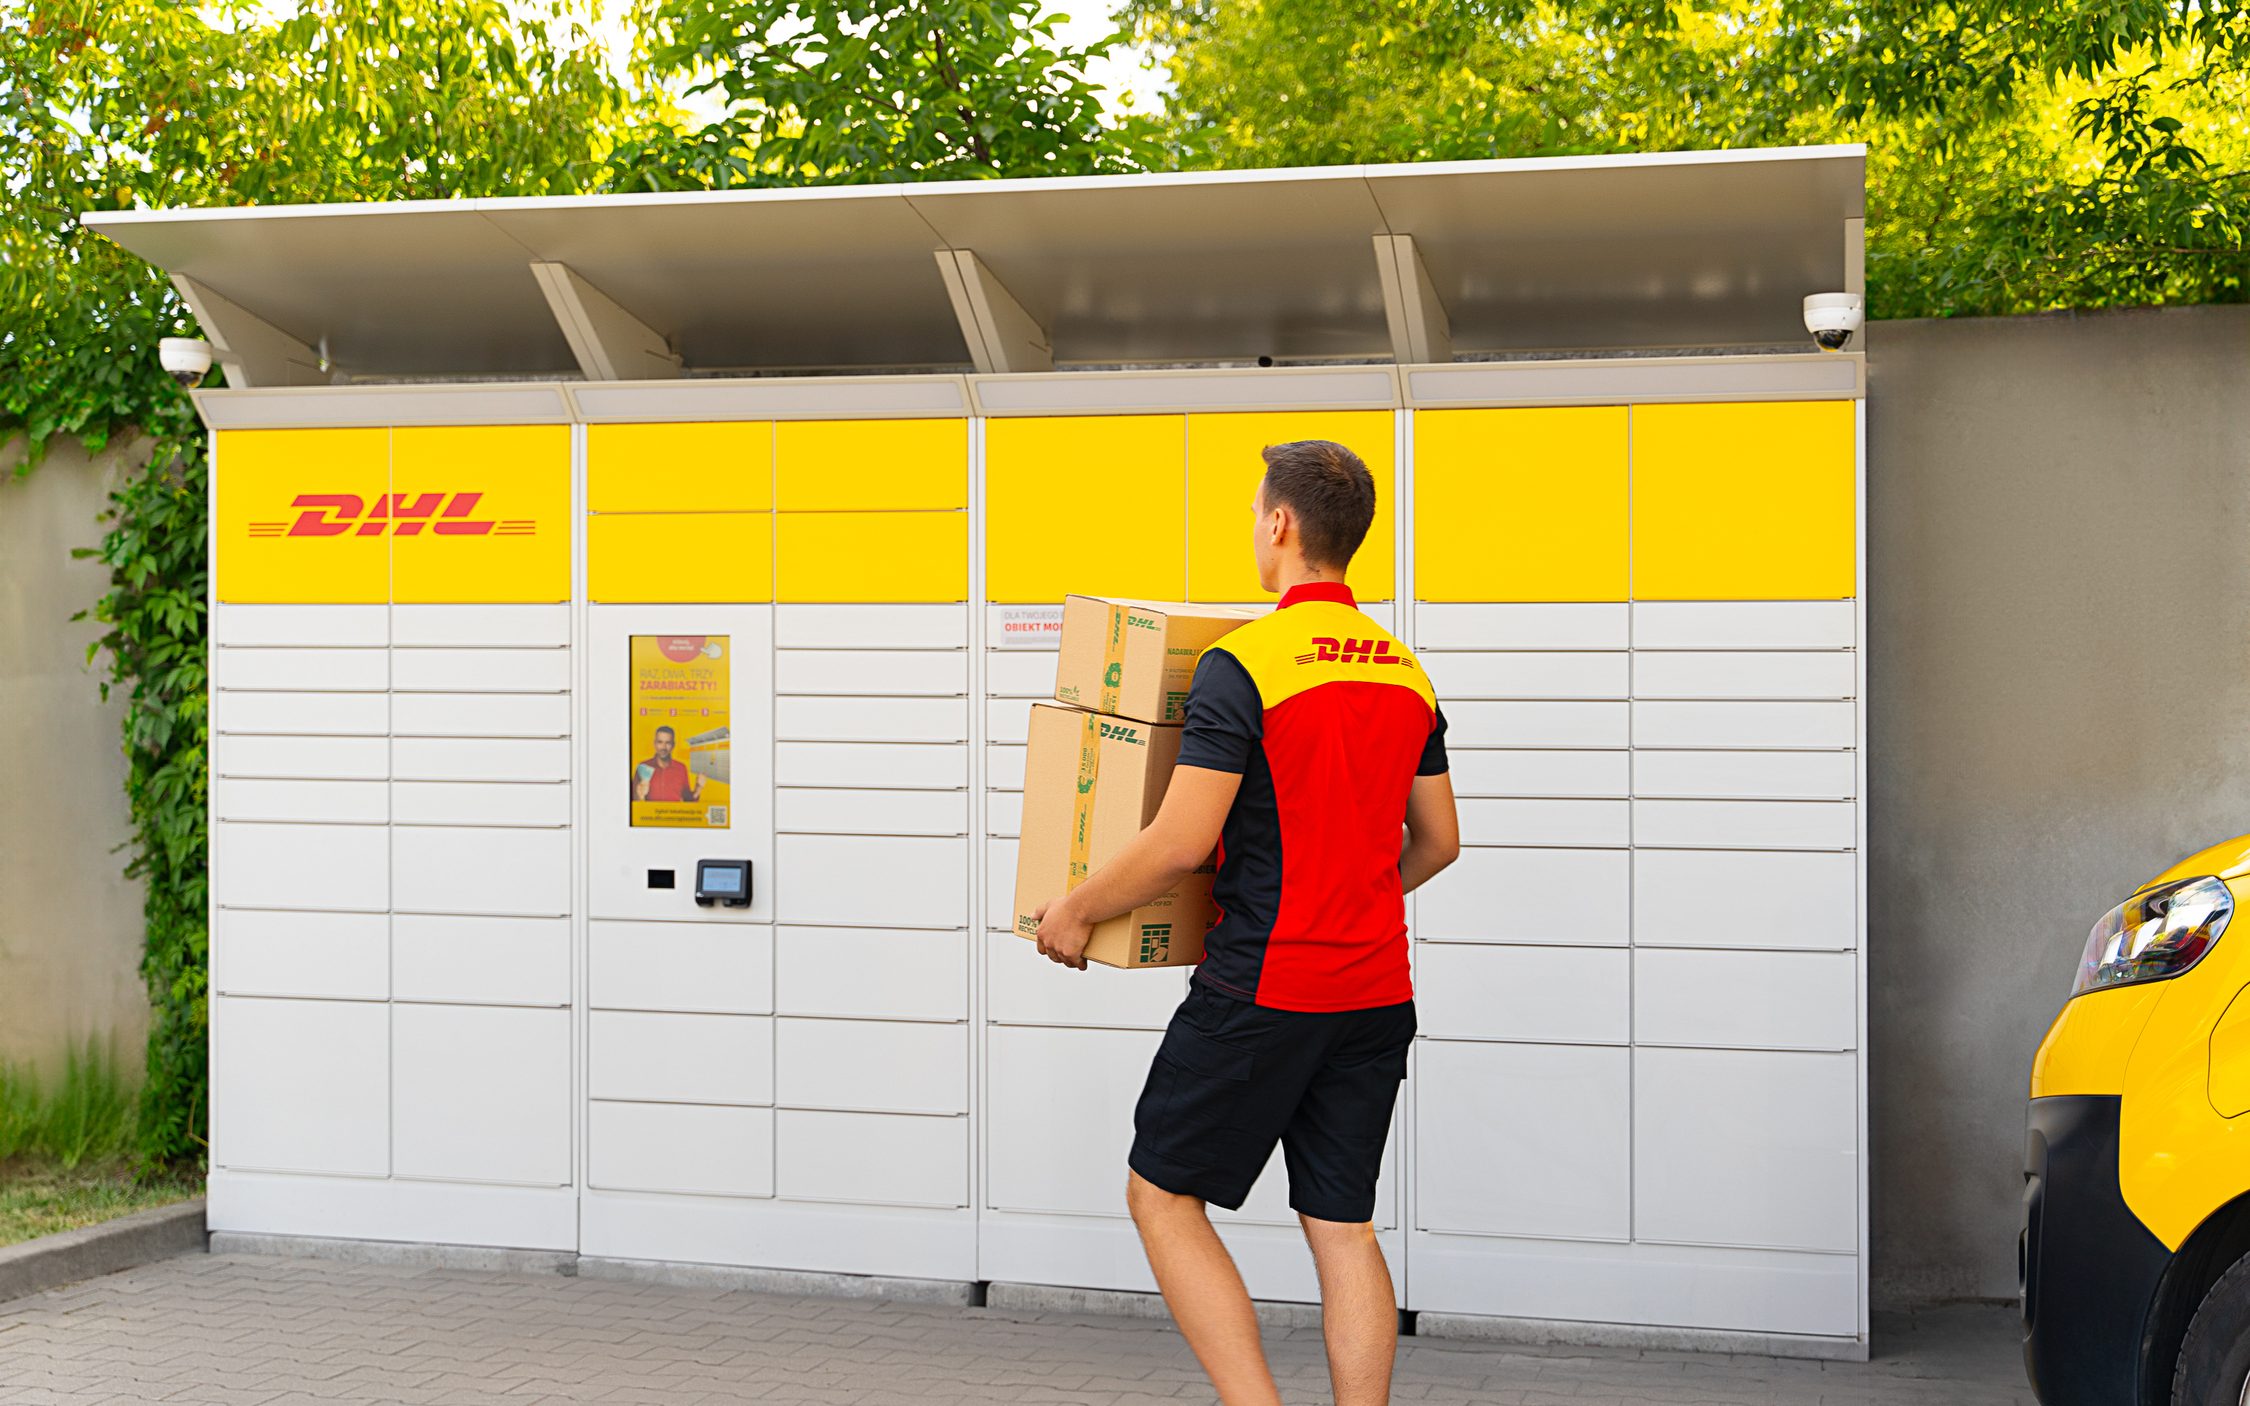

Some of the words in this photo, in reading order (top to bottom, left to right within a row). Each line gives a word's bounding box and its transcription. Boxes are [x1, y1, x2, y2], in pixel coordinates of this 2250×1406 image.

[286, 492, 497, 537] DHL
[1004, 611, 1020, 620] DLA
[1021, 611, 1060, 620] TWOJEGO
[1005, 622, 1041, 632] OBIEKT
[1127, 615, 1156, 631] DHL
[1311, 637, 1401, 665] DHL
[690, 669, 715, 680] TRZY
[640, 681, 697, 691] ZARABIASZ
[700, 681, 718, 691] TY!
[1101, 722, 1137, 744] DHL
